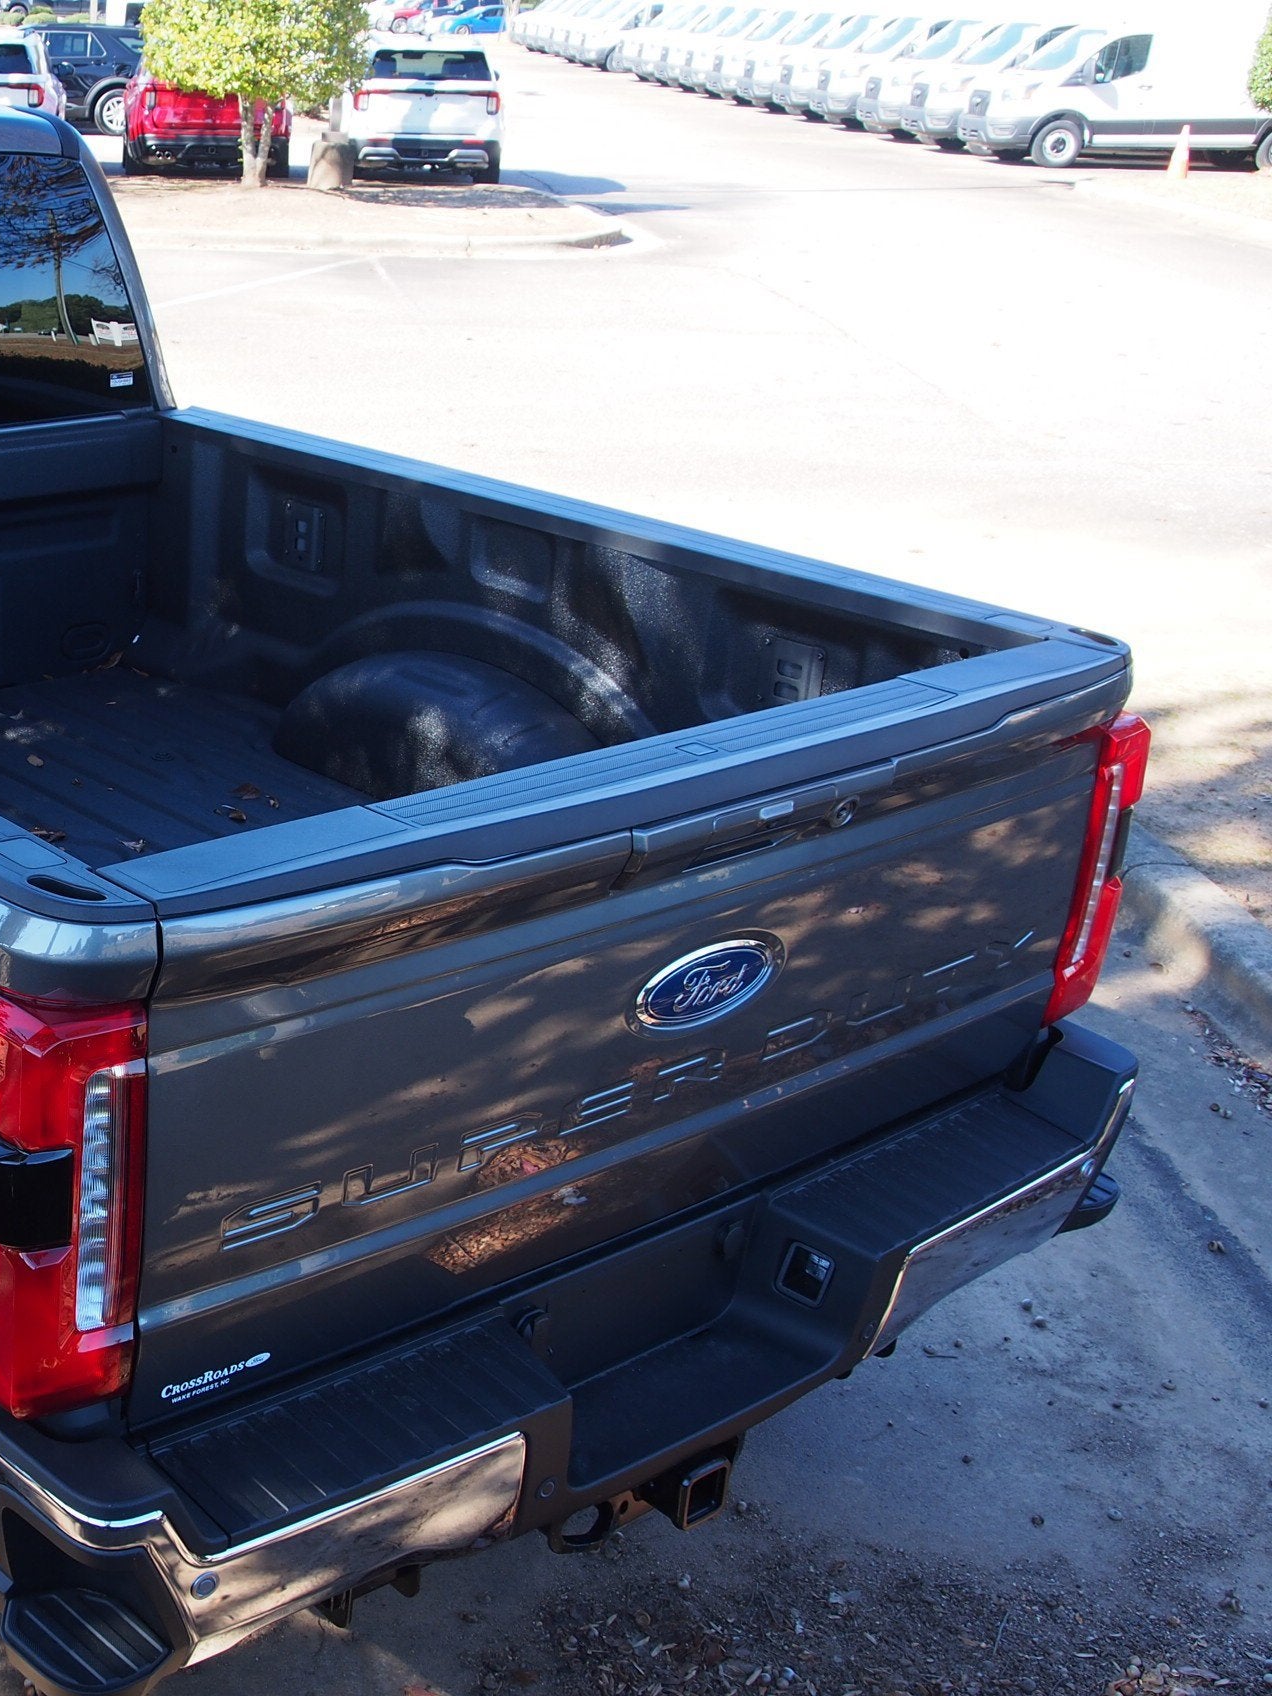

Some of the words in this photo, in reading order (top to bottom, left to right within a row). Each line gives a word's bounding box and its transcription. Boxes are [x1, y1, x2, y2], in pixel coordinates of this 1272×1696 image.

[220, 1047, 727, 1253] SUPER
[760, 930, 1035, 1064] DUTY
[171, 1392, 191, 1404] WAKE
[191, 1383, 219, 1398] FOREST,
[220, 1378, 230, 1386] NC
